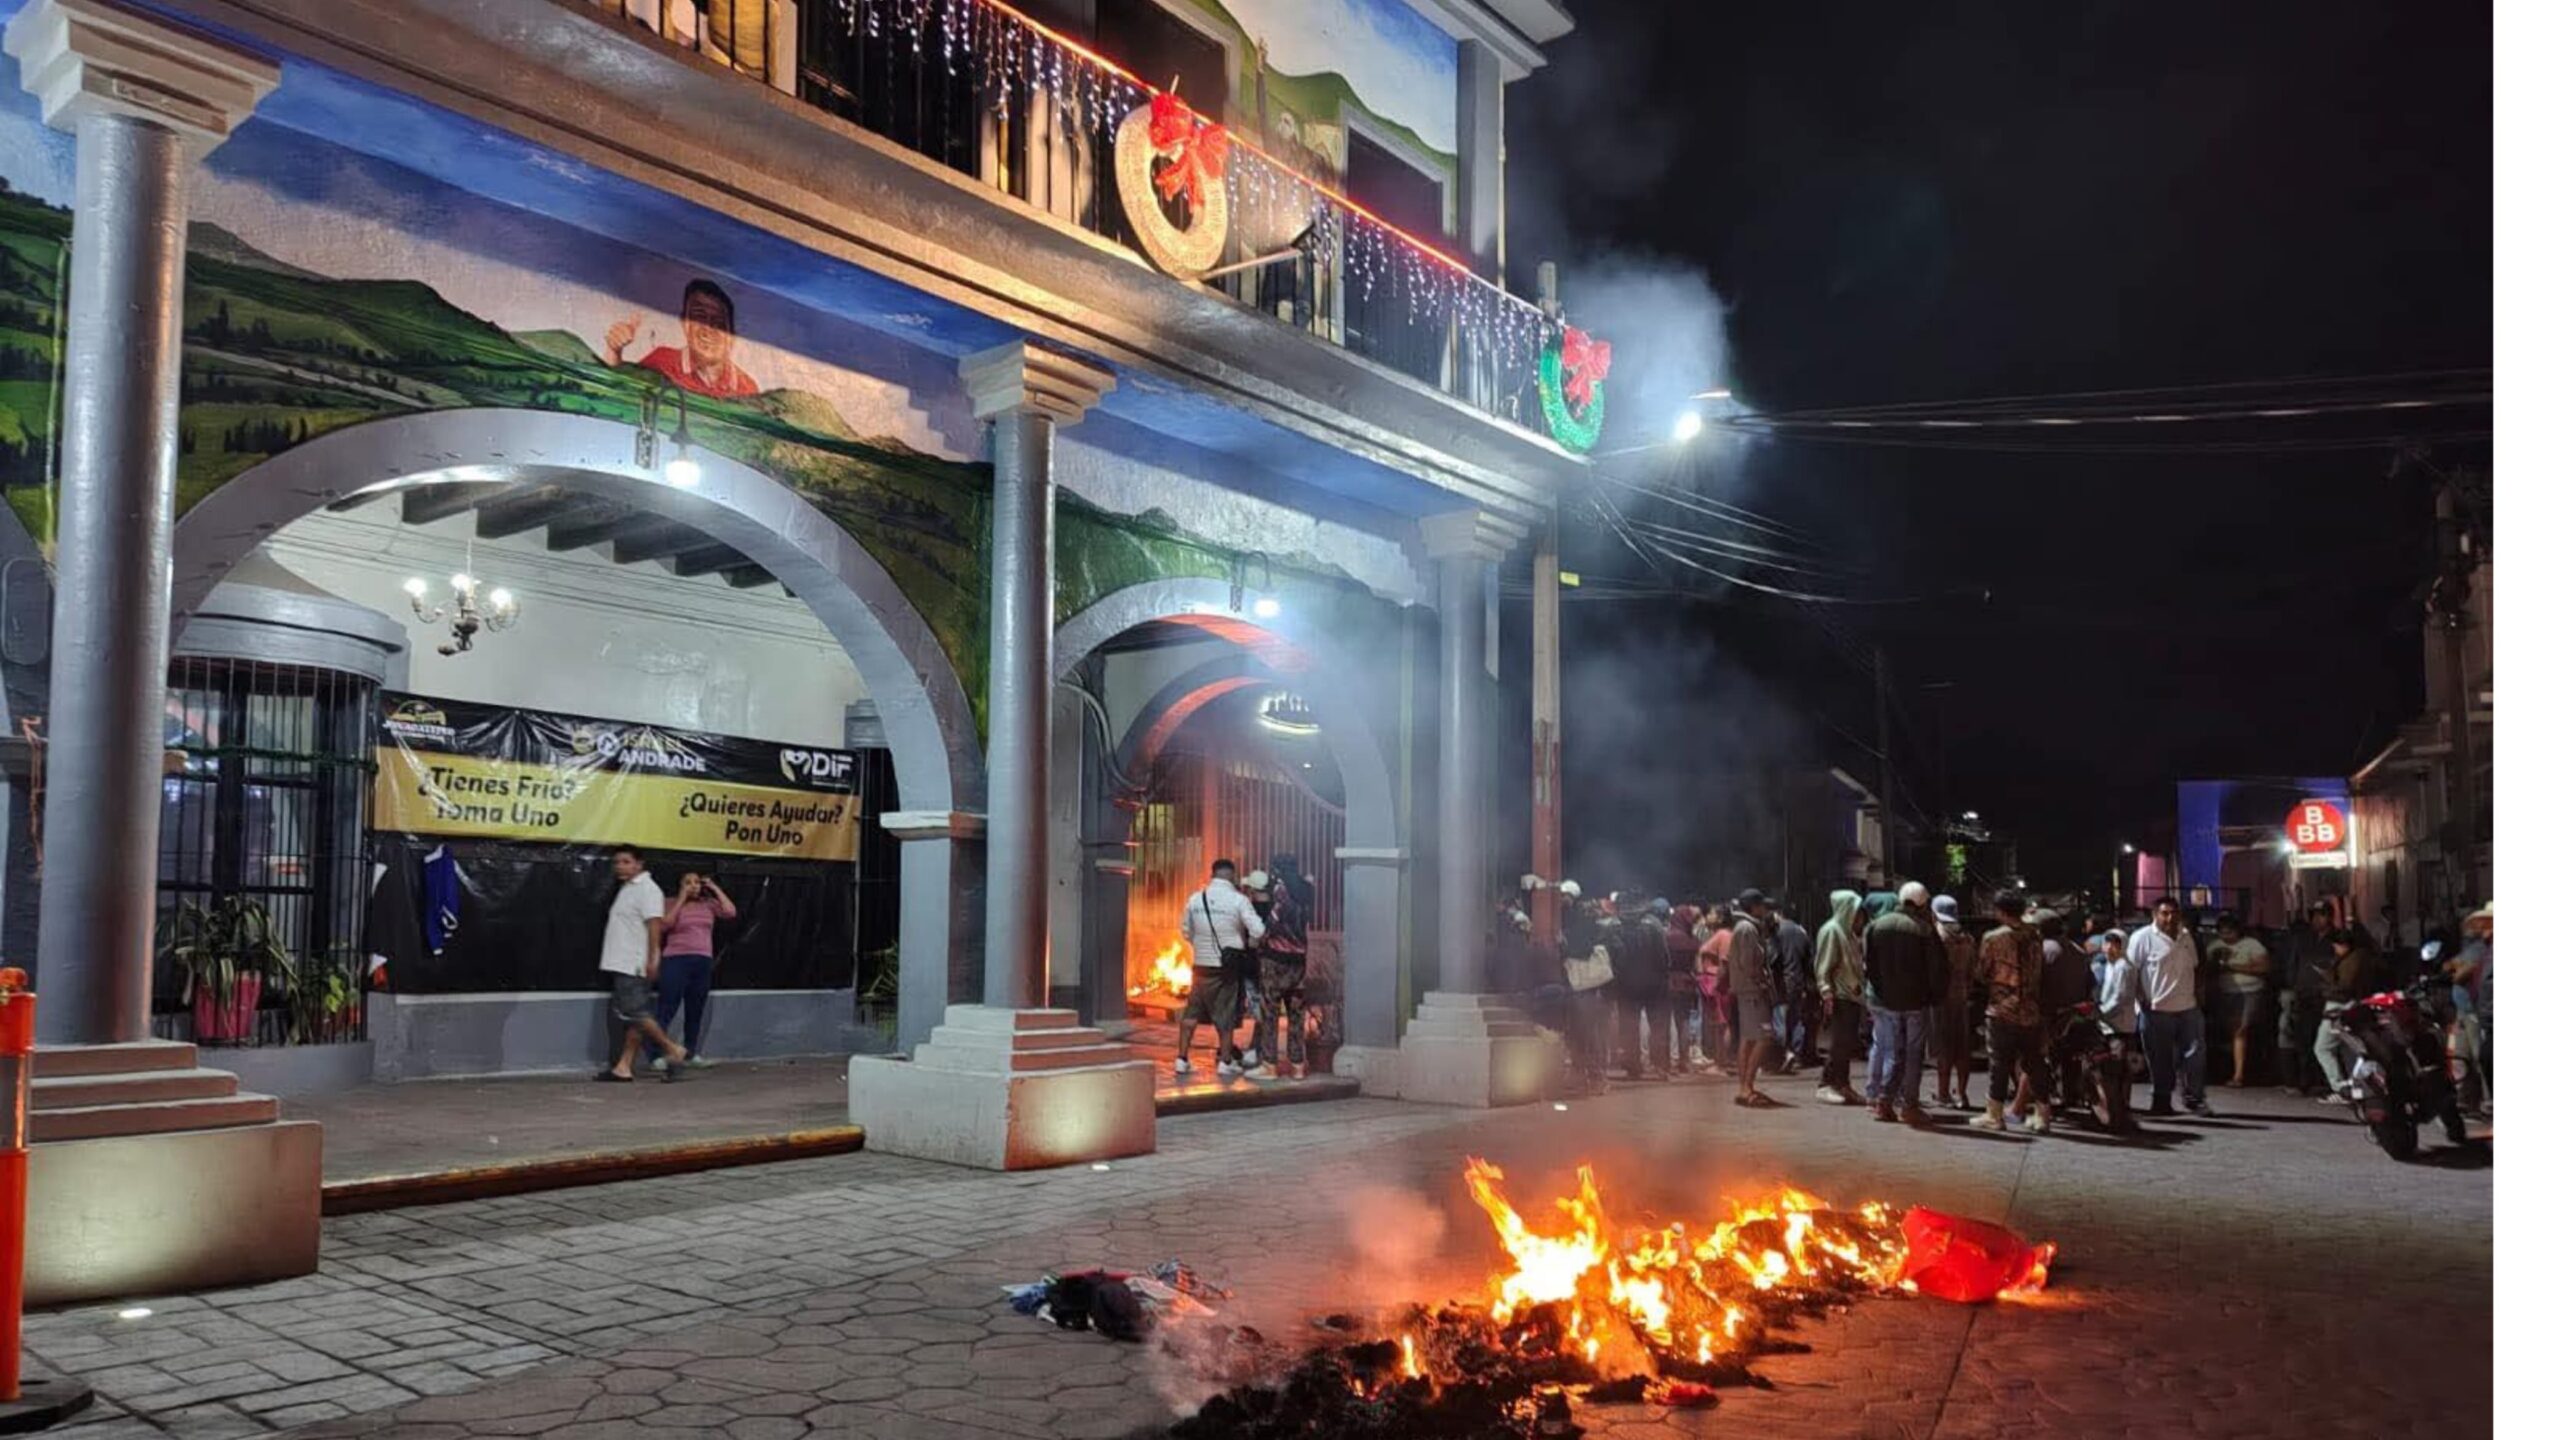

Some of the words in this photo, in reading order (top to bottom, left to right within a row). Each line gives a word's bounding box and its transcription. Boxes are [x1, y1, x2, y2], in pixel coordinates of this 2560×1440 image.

[618, 749, 706, 772] ANDRADE
[511, 802, 559, 827] Uno
[680, 792, 766, 818] ¿Quieres
[769, 800, 843, 825] Ayudar?
[725, 820, 762, 843] Pon
[766, 824, 804, 846] Uno
